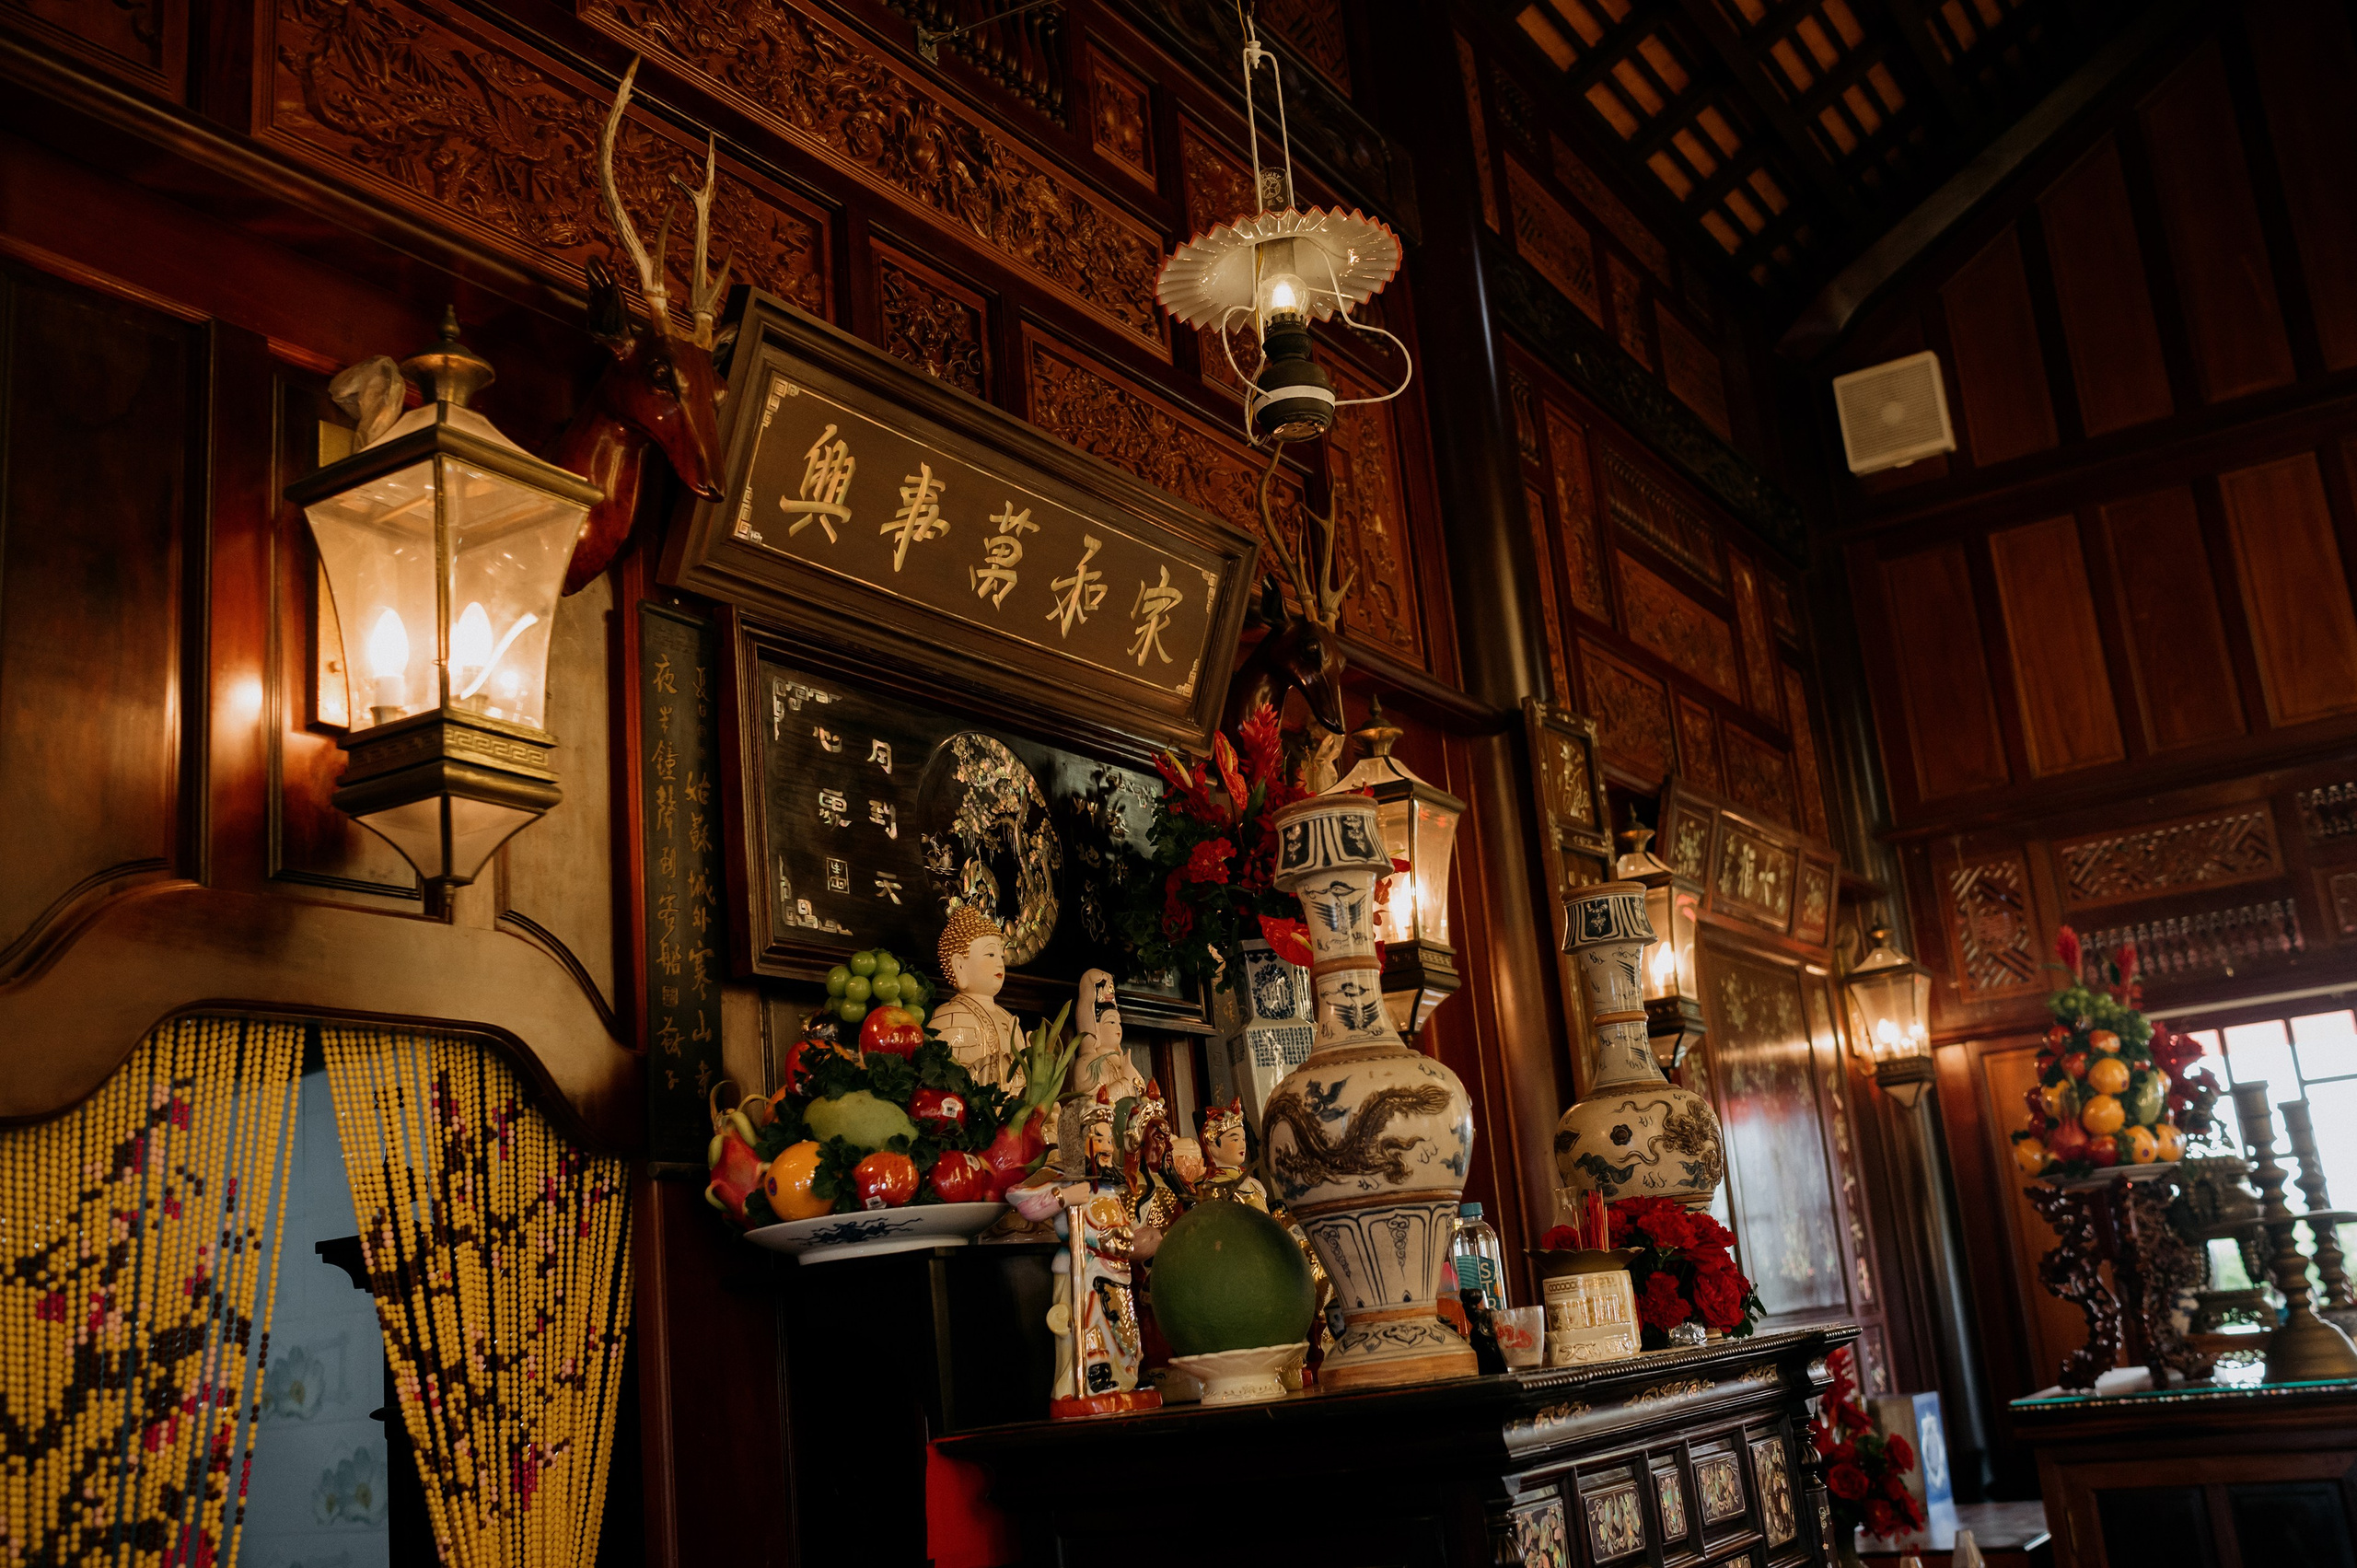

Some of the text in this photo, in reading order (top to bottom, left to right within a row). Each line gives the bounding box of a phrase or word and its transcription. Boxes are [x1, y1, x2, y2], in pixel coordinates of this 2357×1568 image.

[779, 423, 1183, 667] 家和萬事興
